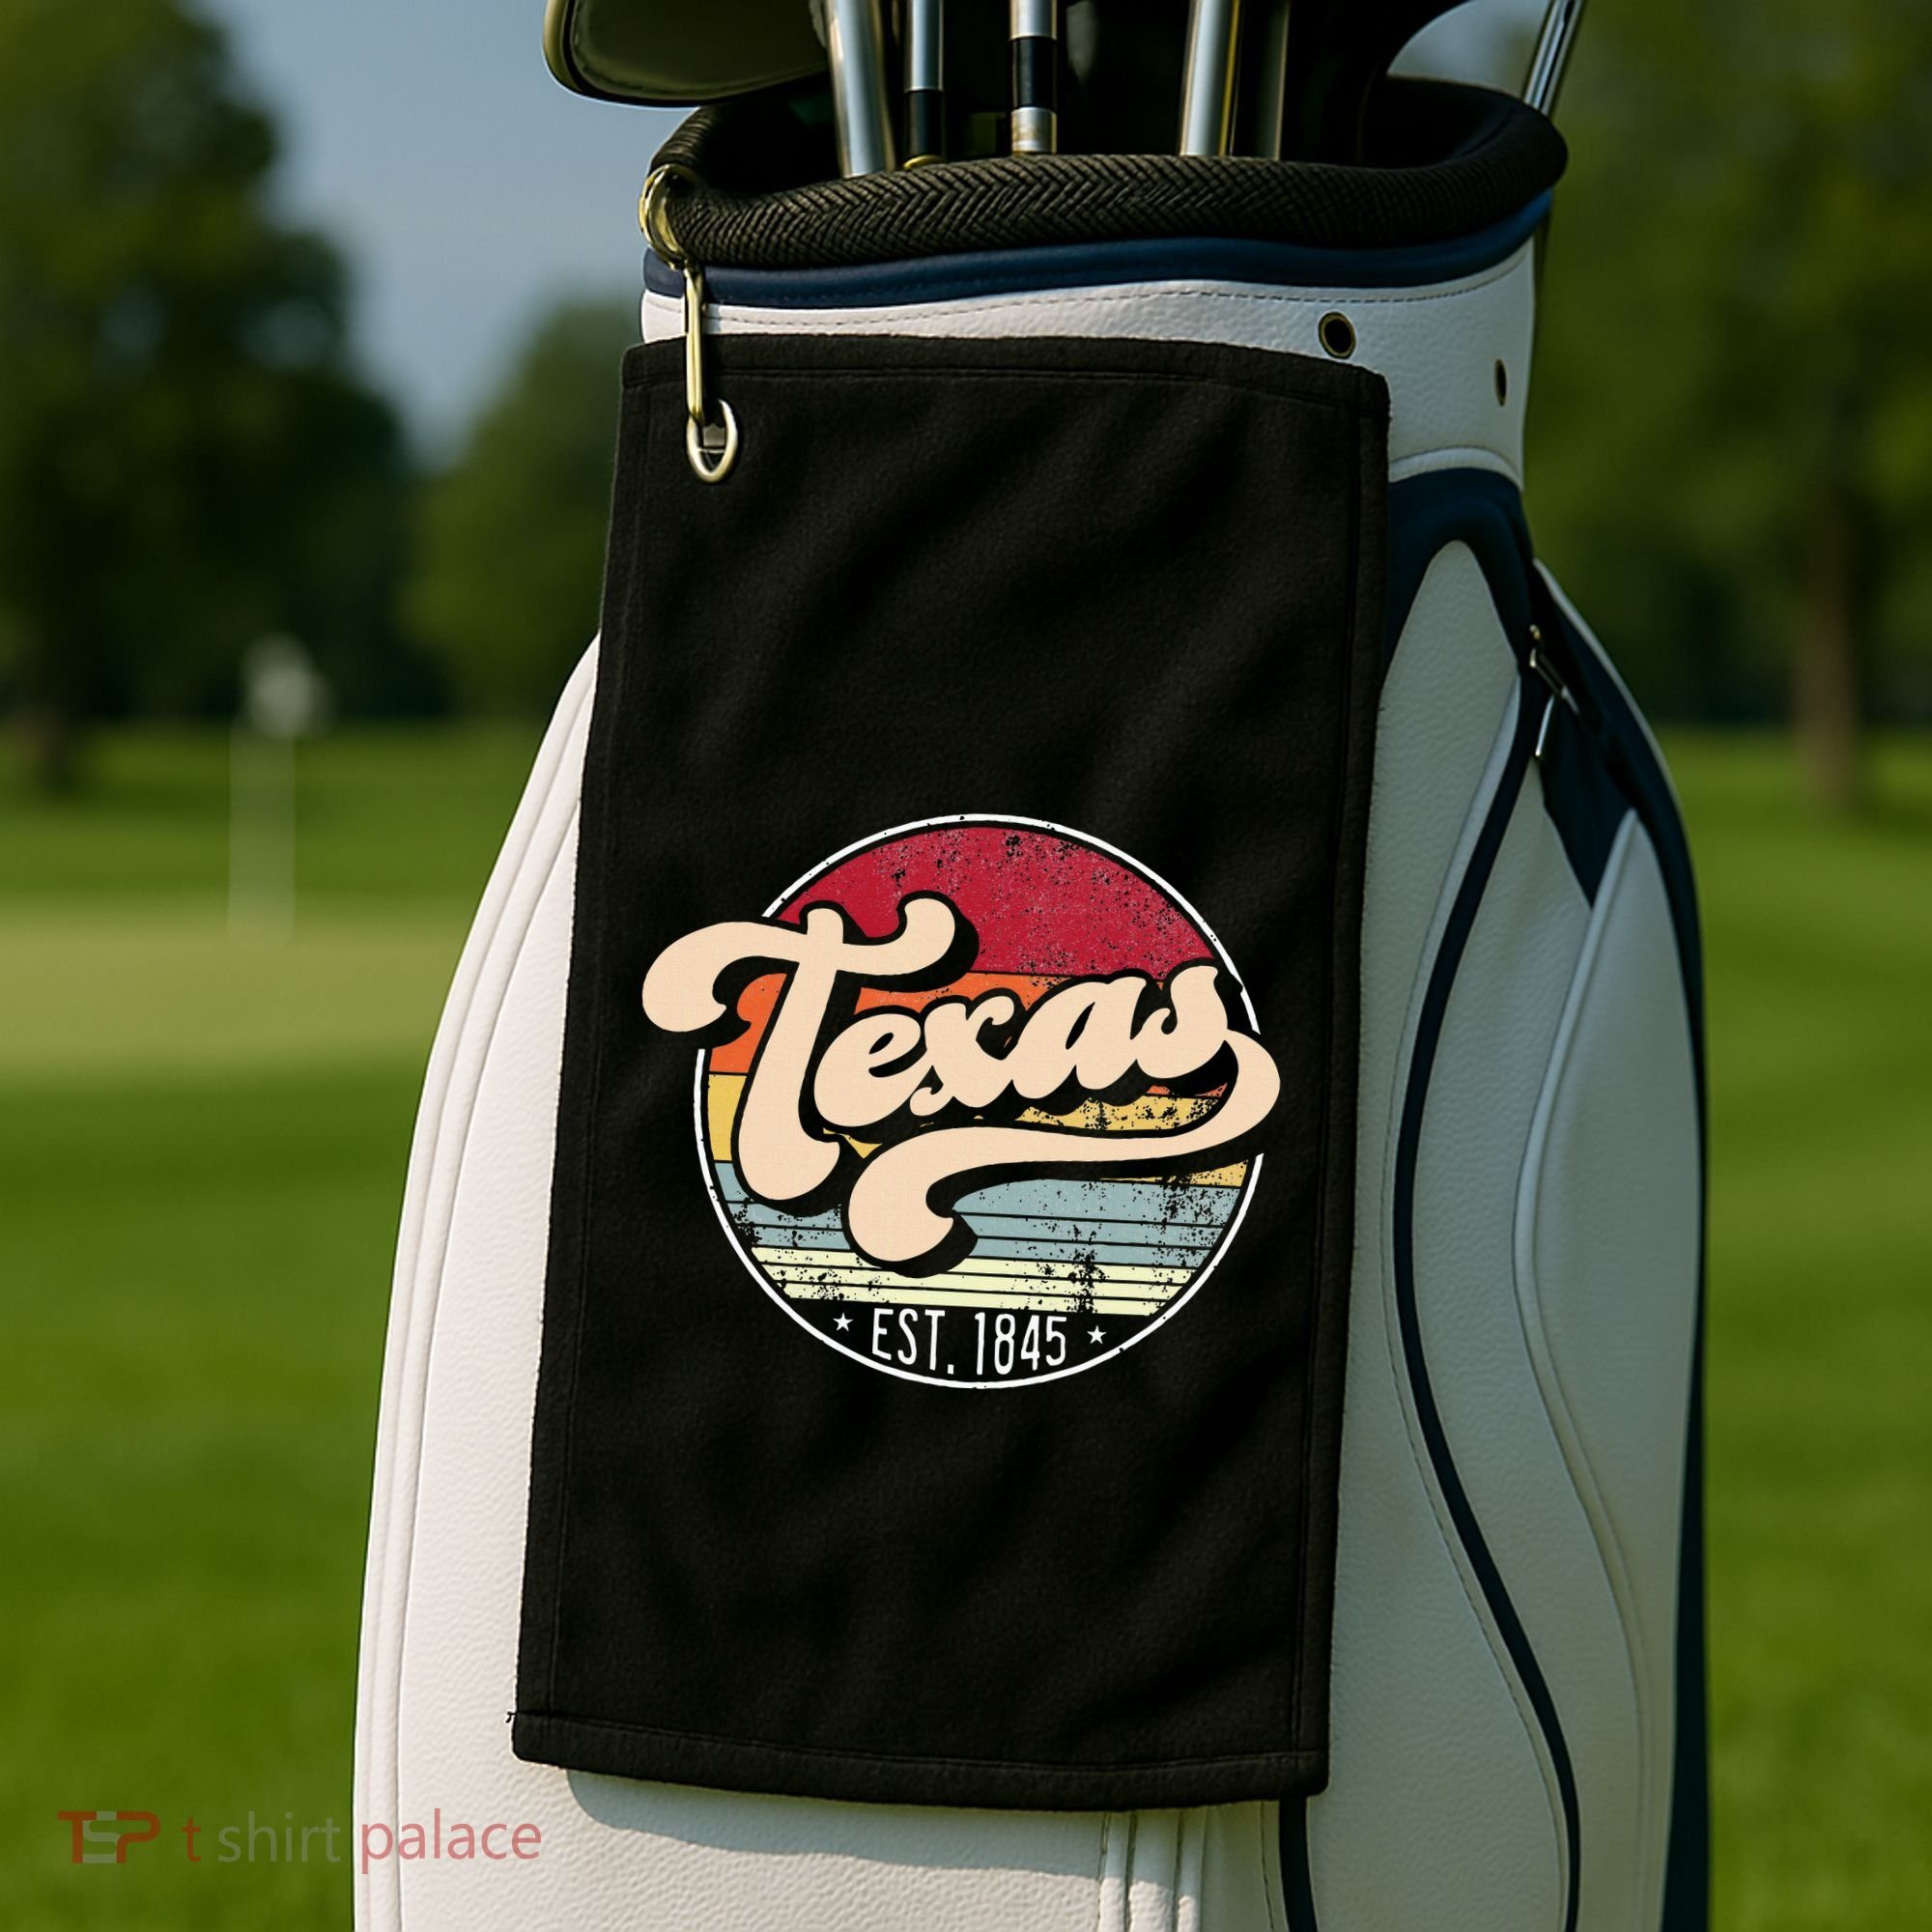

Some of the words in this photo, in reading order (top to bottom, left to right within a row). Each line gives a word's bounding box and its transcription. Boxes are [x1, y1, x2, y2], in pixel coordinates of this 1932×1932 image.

[642, 896, 1281, 1262] Texas
[872, 1307, 954, 1375] EST.
[975, 1312, 1067, 1375] 1845
